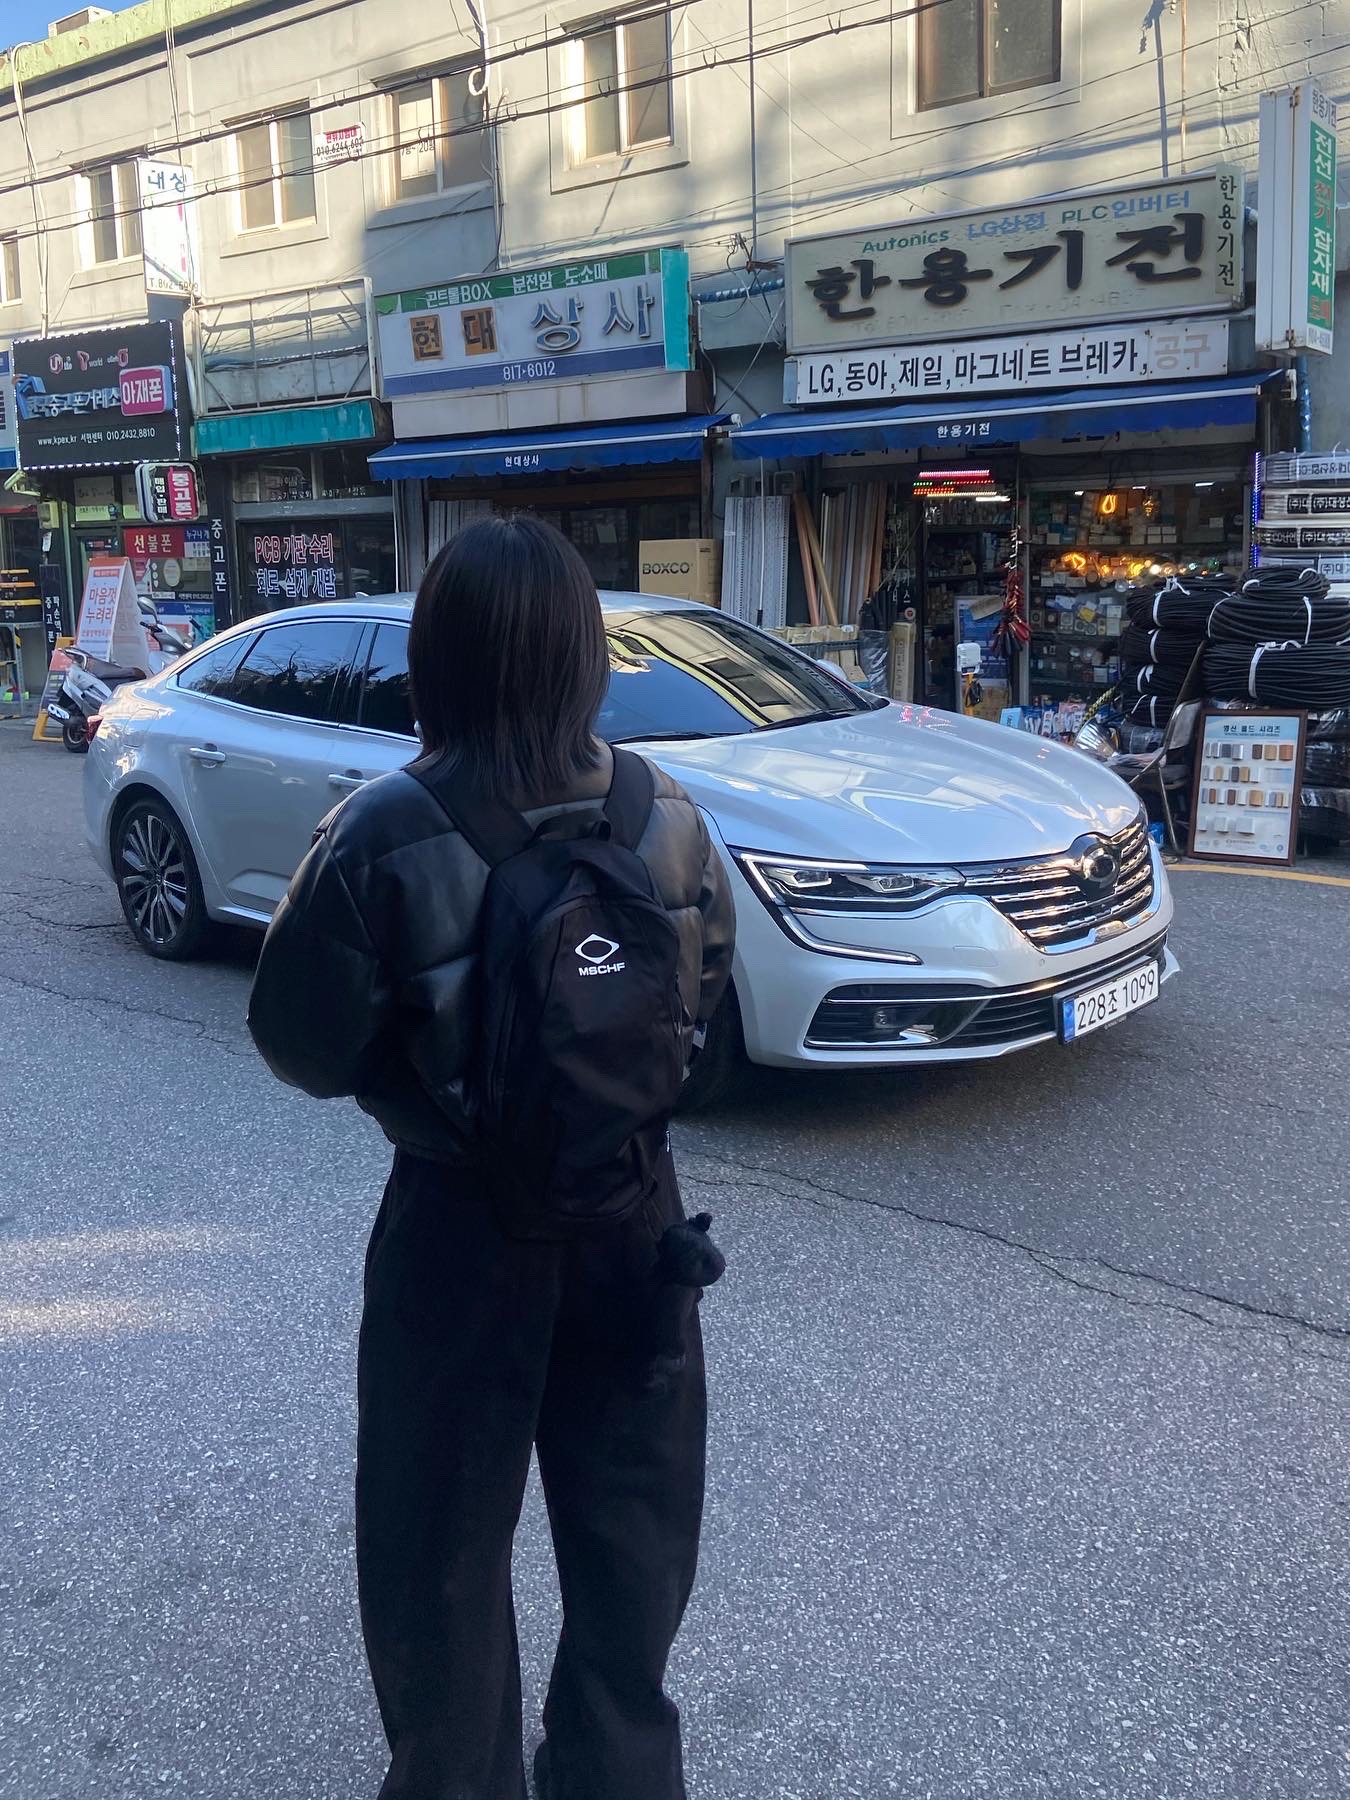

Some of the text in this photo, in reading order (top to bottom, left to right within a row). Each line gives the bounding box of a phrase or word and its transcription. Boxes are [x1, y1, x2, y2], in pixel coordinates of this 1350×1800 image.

[1313, 130, 1332, 181] 전선
[862, 229, 949, 254] Autonics
[1216, 175, 1237, 287] 한용기전
[512, 271, 553, 295] 분전함
[565, 262, 608, 287] 도소매
[805, 213, 1206, 320] 한용기전
[1311, 227, 1332, 295] 잡자재
[412, 283, 655, 359] 현대상사
[937, 422, 991, 439] 한용기전
[504, 454, 539, 467] 현대상사
[172, 473, 193, 516] 중고폰
[134, 534, 172, 554] 선불폰
[211, 519, 227, 592] 중고폰
[254, 533, 334, 564] PCB 기판 수리
[256, 567, 336, 598] 회로 설계 개발
[642, 562, 690, 575] BOXCO
[45, 596, 55, 643] 중고폰
[578, 962, 625, 977] MSCHF
[1077, 969, 1155, 1031] 228조 1099
